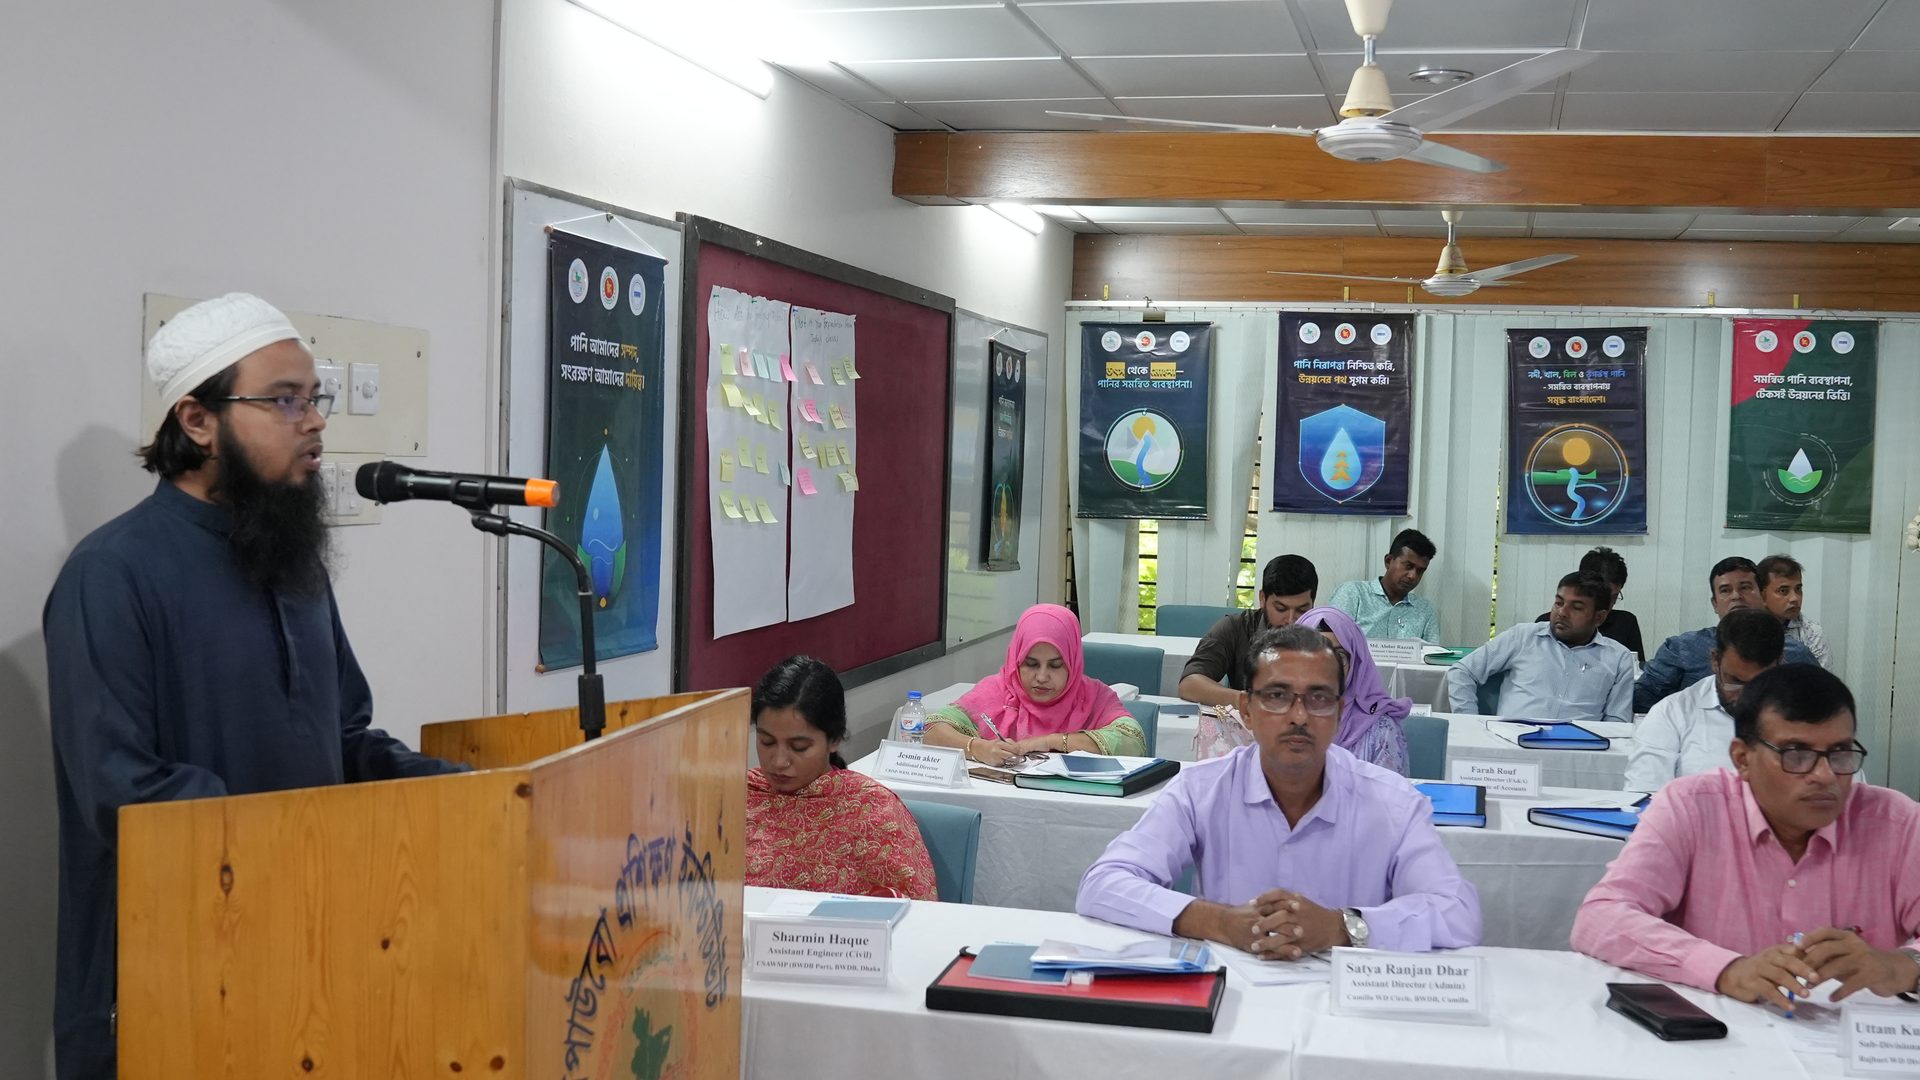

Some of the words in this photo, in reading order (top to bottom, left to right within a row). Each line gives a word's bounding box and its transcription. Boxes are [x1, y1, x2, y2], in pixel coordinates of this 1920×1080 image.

[570, 332, 588, 353] পানি
[589, 338, 620, 358] আমাদের
[621, 343, 639, 363] সম্পদ,
[1128, 365, 1149, 375] থেকে
[1293, 359, 1311, 370] পানি
[1313, 359, 1345, 370] নিরাপত্তা
[1347, 360, 1374, 371] নিশ্চিত
[1376, 360, 1395, 372] করি,
[561, 364, 593, 383] সংরক্ষণ
[594, 368, 624, 387] আমাদের
[1298, 373, 1331, 384] উন্নয়নের
[1333, 375, 1347, 384] পথ
[1349, 376, 1368, 387] সুগম
[1370, 374, 1390, 385] করি।
[1528, 369, 1542, 380] নদী,
[1544, 371, 1561, 380] খাল,
[1563, 370, 1577, 378] বিল
[1610, 369, 1626, 378] পানি
[1753, 373, 1785, 385] সমন্বিত
[1787, 373, 1806, 385] পানি
[1808, 375, 1853, 387] ব্যবস্থাপনা,
[1097, 378, 1120, 389] পানির
[1122, 378, 1150, 389] সমন্বিত
[1152, 380, 1193, 389] ব্যবস্থাপনা।
[1548, 382, 1572, 391] সমন্বিত
[1573, 383, 1611, 391] ব্যবস্থাপনায়
[1547, 396, 1567, 405] সমৃদ্ধ
[1568, 396, 1606, 404] বাংলাদেশ।
[1755, 388, 1786, 399] টেকসই
[1787, 388, 1824, 400] উন্নয়নের
[1826, 389, 1851, 401] ভিত্তি।
[897, 751, 921, 761] Jesmin
[922, 755, 941, 763] akter
[1471, 766, 1495, 774] Farah
[1497, 767, 1517, 775] Rouf
[772, 931, 825, 944] Sharmin
[829, 934, 870, 948] Haque
[768, 947, 804, 956] Assistant
[806, 949, 843, 959] Engineer
[845, 950, 872, 959] (Civil)
[860, 964, 881, 972] Dhaka
[1346, 962, 1381, 977] Satya
[1386, 964, 1432, 978] Ranjan
[1437, 965, 1469, 976] Dhar
[1351, 979, 1389, 988] Assistant
[1391, 980, 1426, 989] Director
[1429, 981, 1466, 990] (Admin)
[1855, 1022, 1896, 1035] Uttam
